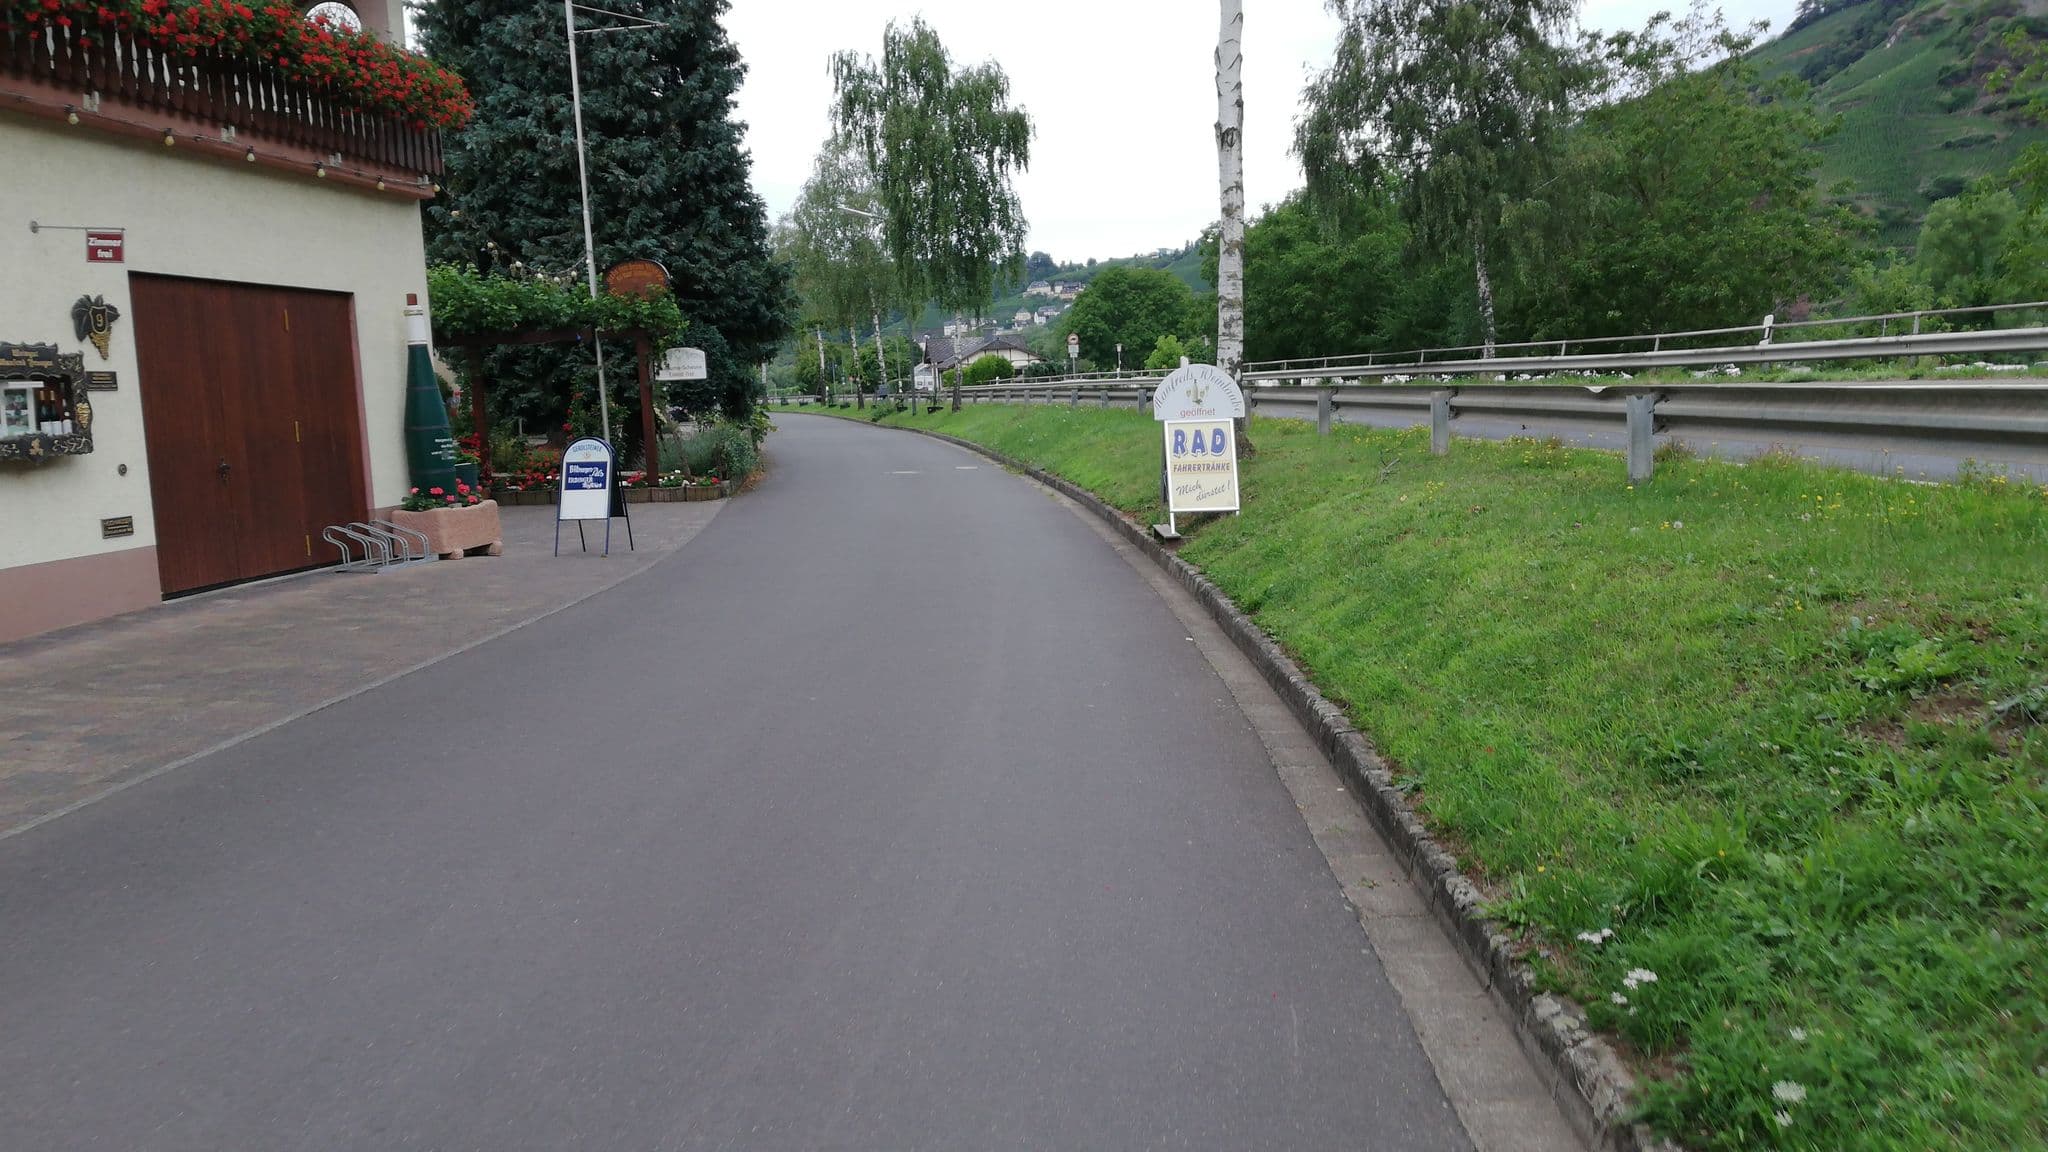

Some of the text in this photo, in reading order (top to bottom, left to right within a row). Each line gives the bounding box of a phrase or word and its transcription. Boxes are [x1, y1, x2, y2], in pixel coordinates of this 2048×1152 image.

[88, 237, 122, 246] Zimmer
[97, 248, 113, 258] frei
[96, 313, 104, 327] 9
[1180, 407, 1216, 418] geöffnet
[1173, 428, 1226, 457] RAD
[1175, 479, 1202, 496] Mich
